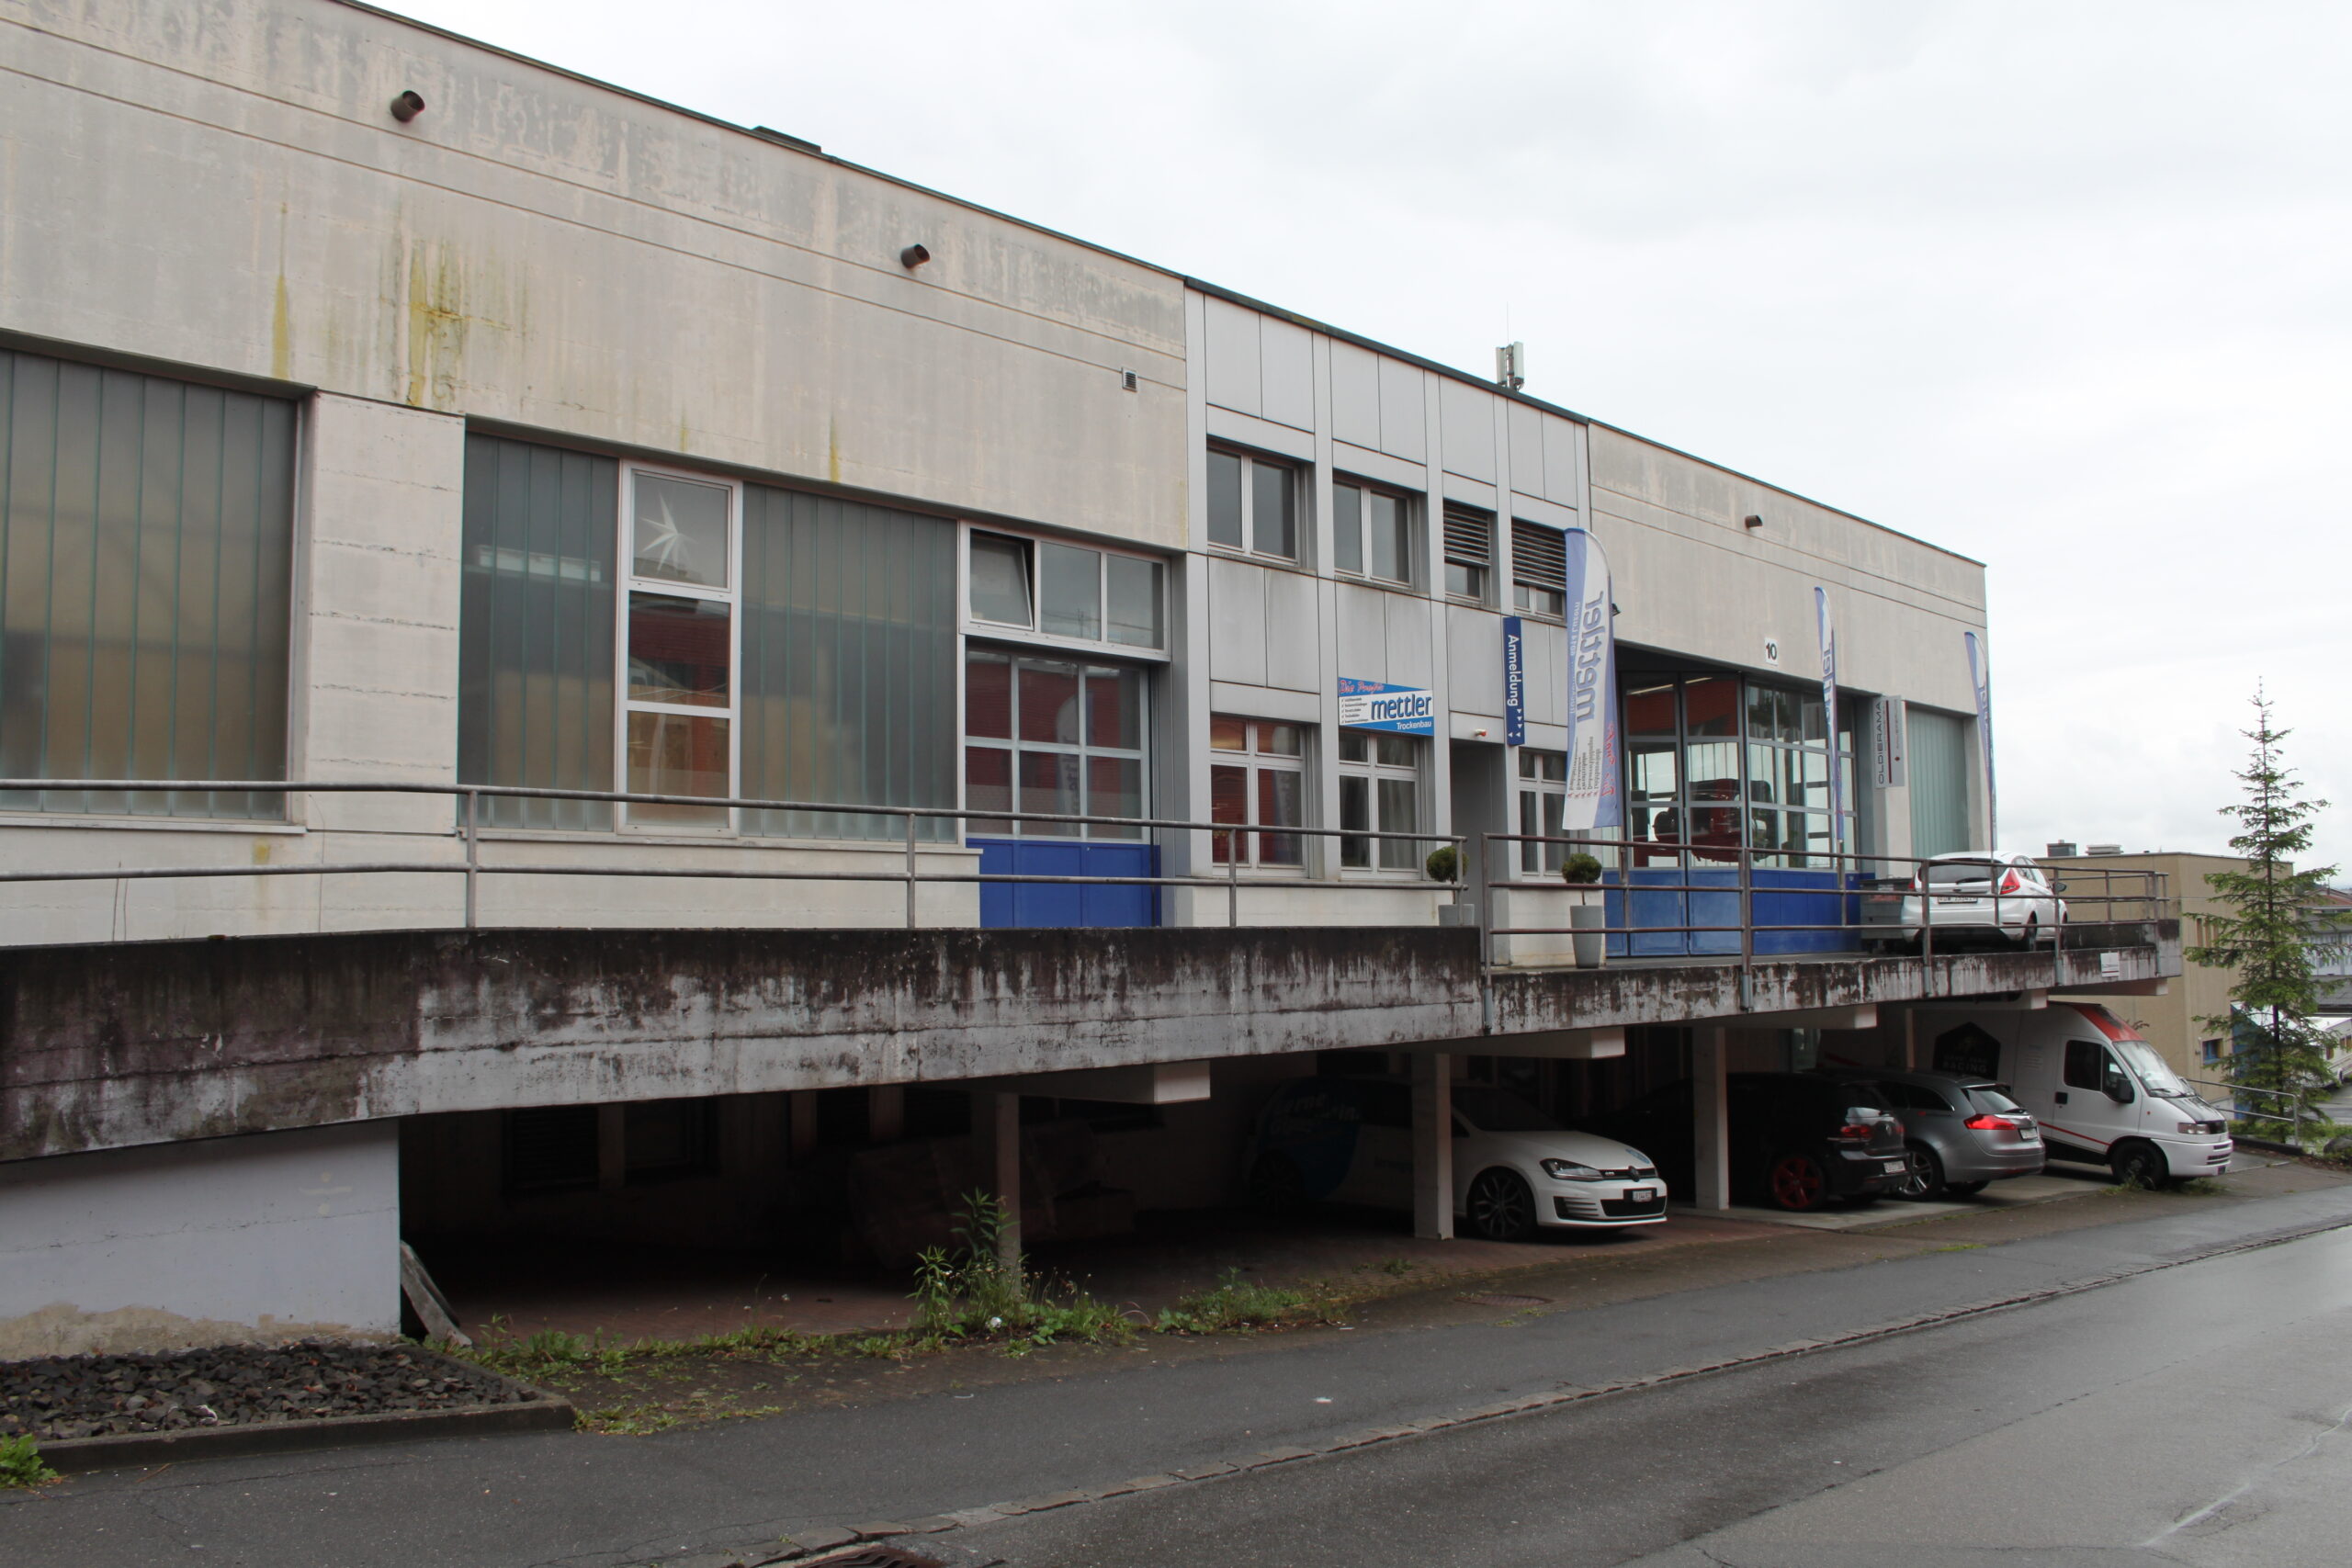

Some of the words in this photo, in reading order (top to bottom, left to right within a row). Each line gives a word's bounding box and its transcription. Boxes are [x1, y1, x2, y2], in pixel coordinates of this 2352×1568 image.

[1766, 642, 1777, 660] 10
[1508, 634, 1522, 707] Anmeldung
[1339, 680, 1355, 694] Die
[1371, 694, 1432, 720] mettler
[1396, 720, 1432, 730] Trockenbau
[1875, 701, 1884, 784] OLDIERAMA
